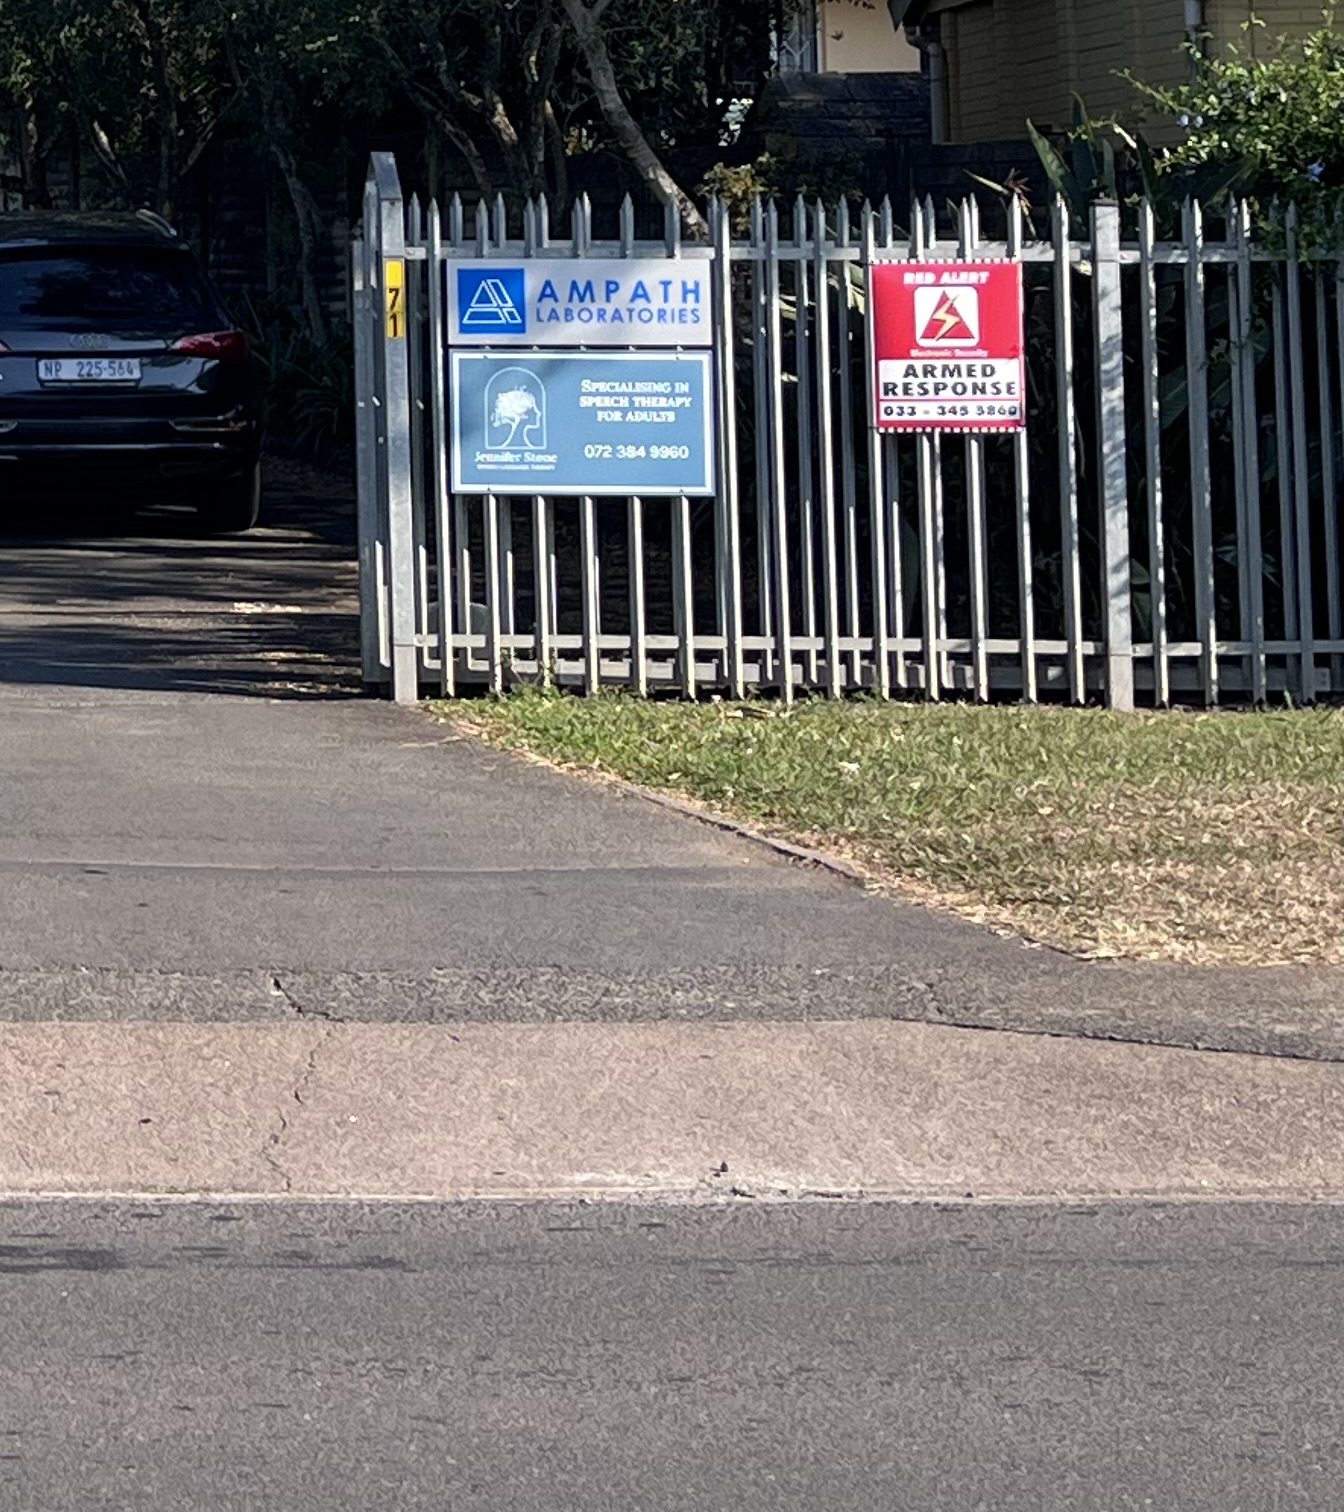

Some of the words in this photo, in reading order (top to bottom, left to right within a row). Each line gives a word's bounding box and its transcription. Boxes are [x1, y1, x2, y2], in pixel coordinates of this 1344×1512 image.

[903, 272, 936, 285] RED
[939, 271, 990, 285] ALERT
[537, 279, 701, 304] AMPATH
[536, 307, 701, 324] LABORATORIES
[43, 360, 62, 378] NP
[902, 363, 997, 379] ARMED
[580, 379, 672, 394] SPECIALISING
[674, 381, 690, 393] IN
[882, 381, 1017, 397] RESPONSE
[579, 395, 630, 408] SPEECH
[632, 395, 692, 408] THERAPY
[596, 410, 624, 423] FOR
[625, 410, 677, 423] ADULTS
[883, 405, 917, 417] 033
[936, 405, 969, 417] 345
[583, 444, 613, 459] 072
